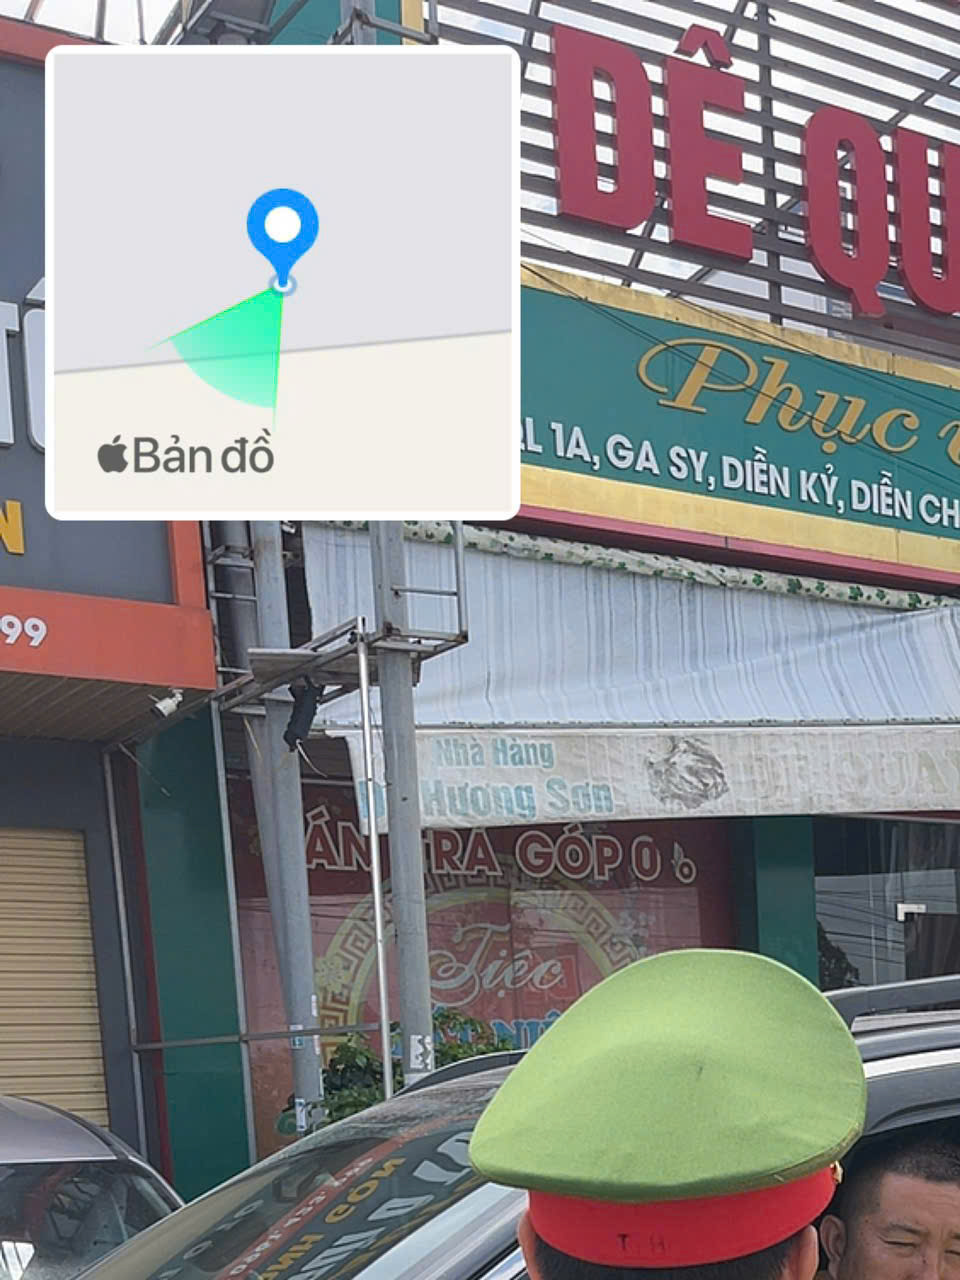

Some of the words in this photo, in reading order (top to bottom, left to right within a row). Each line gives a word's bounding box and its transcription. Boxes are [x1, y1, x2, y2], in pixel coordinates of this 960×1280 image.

[551, 23, 754, 261] DÊ
[636, 337, 921, 455] Phục
[550, 421, 601, 471] 1A,
[606, 433, 661, 476] GA
[667, 445, 717, 491] SY,
[799, 463, 845, 514] KỶ,
[850, 470, 914, 521] DIỄN
[420, 779, 538, 818] Hương
[544, 777, 616, 815] Sơn
[436, 739, 486, 768] Nhà
[491, 737, 556, 770] Hàng
[305, 804, 373, 872] ÁN
[515, 824, 624, 881] GÓP
